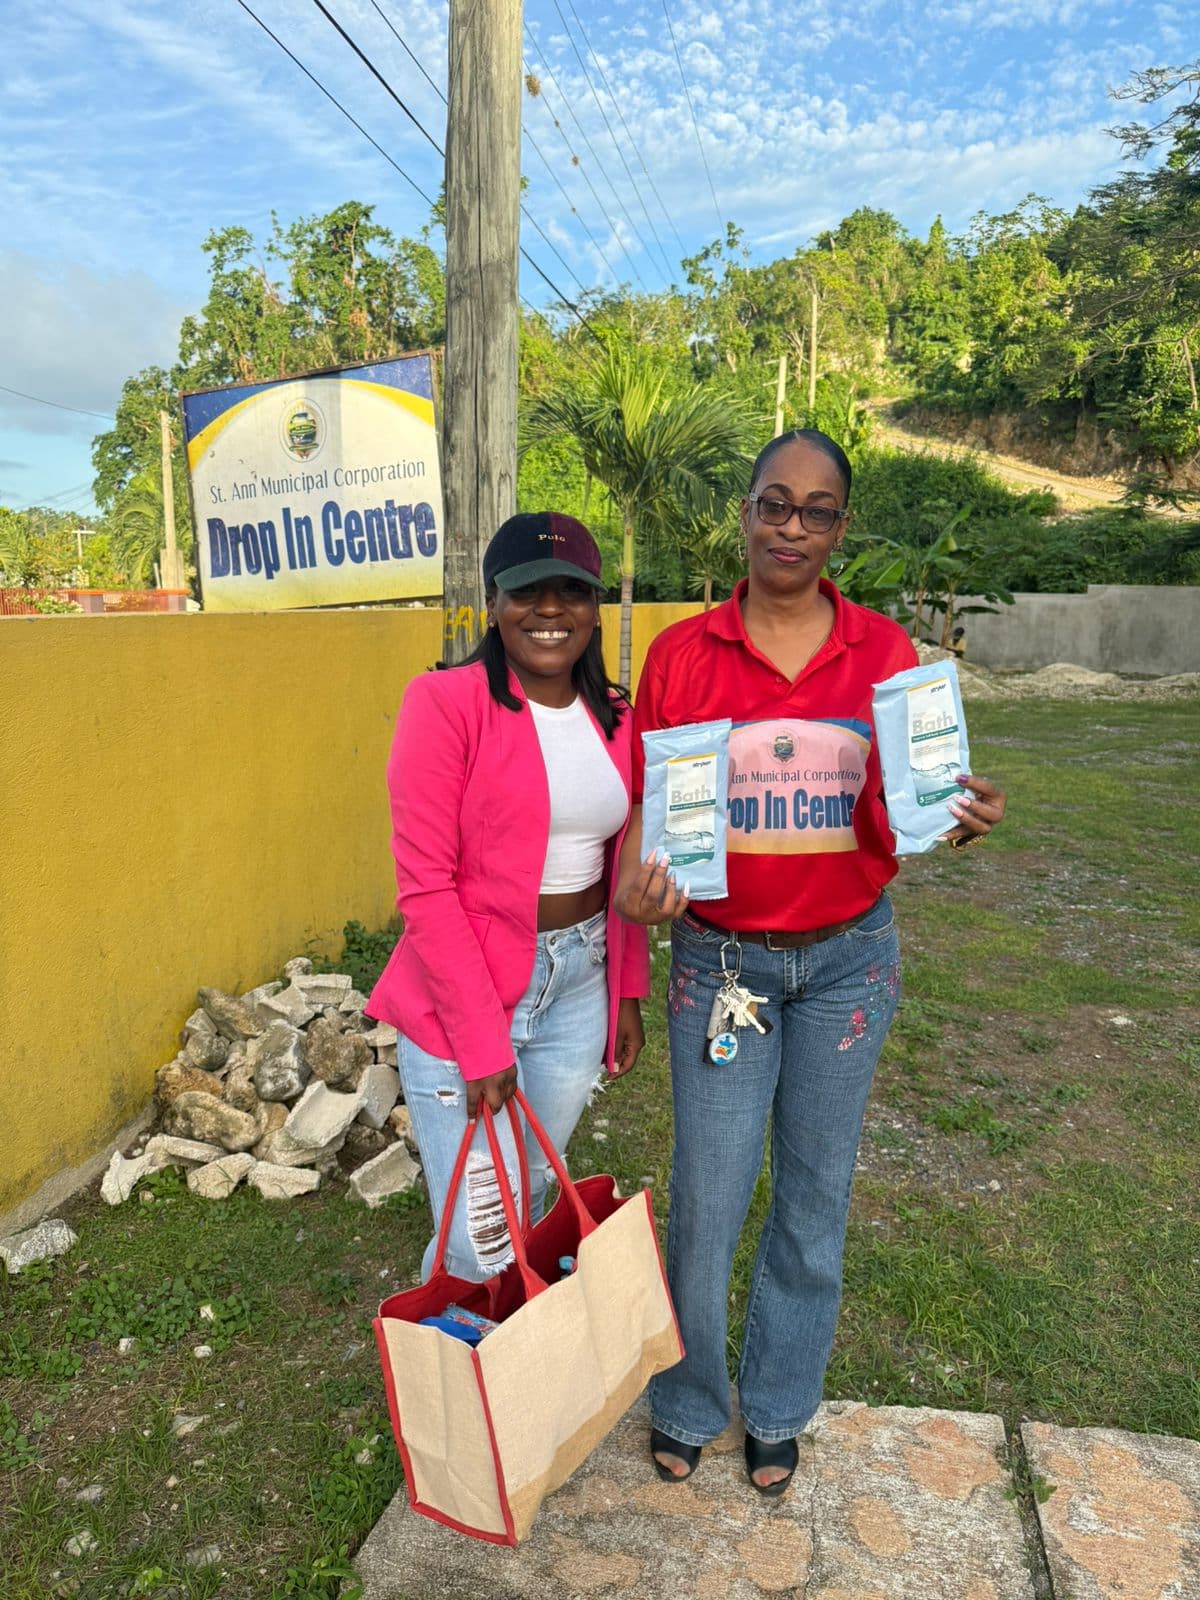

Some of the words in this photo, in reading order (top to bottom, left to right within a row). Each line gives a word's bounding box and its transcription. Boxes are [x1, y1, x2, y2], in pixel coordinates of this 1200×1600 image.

[210, 485, 227, 504] St.
[232, 482, 257, 501] Ann
[261, 470, 328, 494] Municipal
[334, 459, 426, 487] Corporation
[207, 517, 280, 579] Drop
[282, 507, 317, 570] In
[321, 500, 437, 567] Centre
[912, 711, 953, 735] Bath
[751, 770, 800, 783] Municipal
[671, 785, 711, 804] Bath
[764, 790, 787, 829] In
